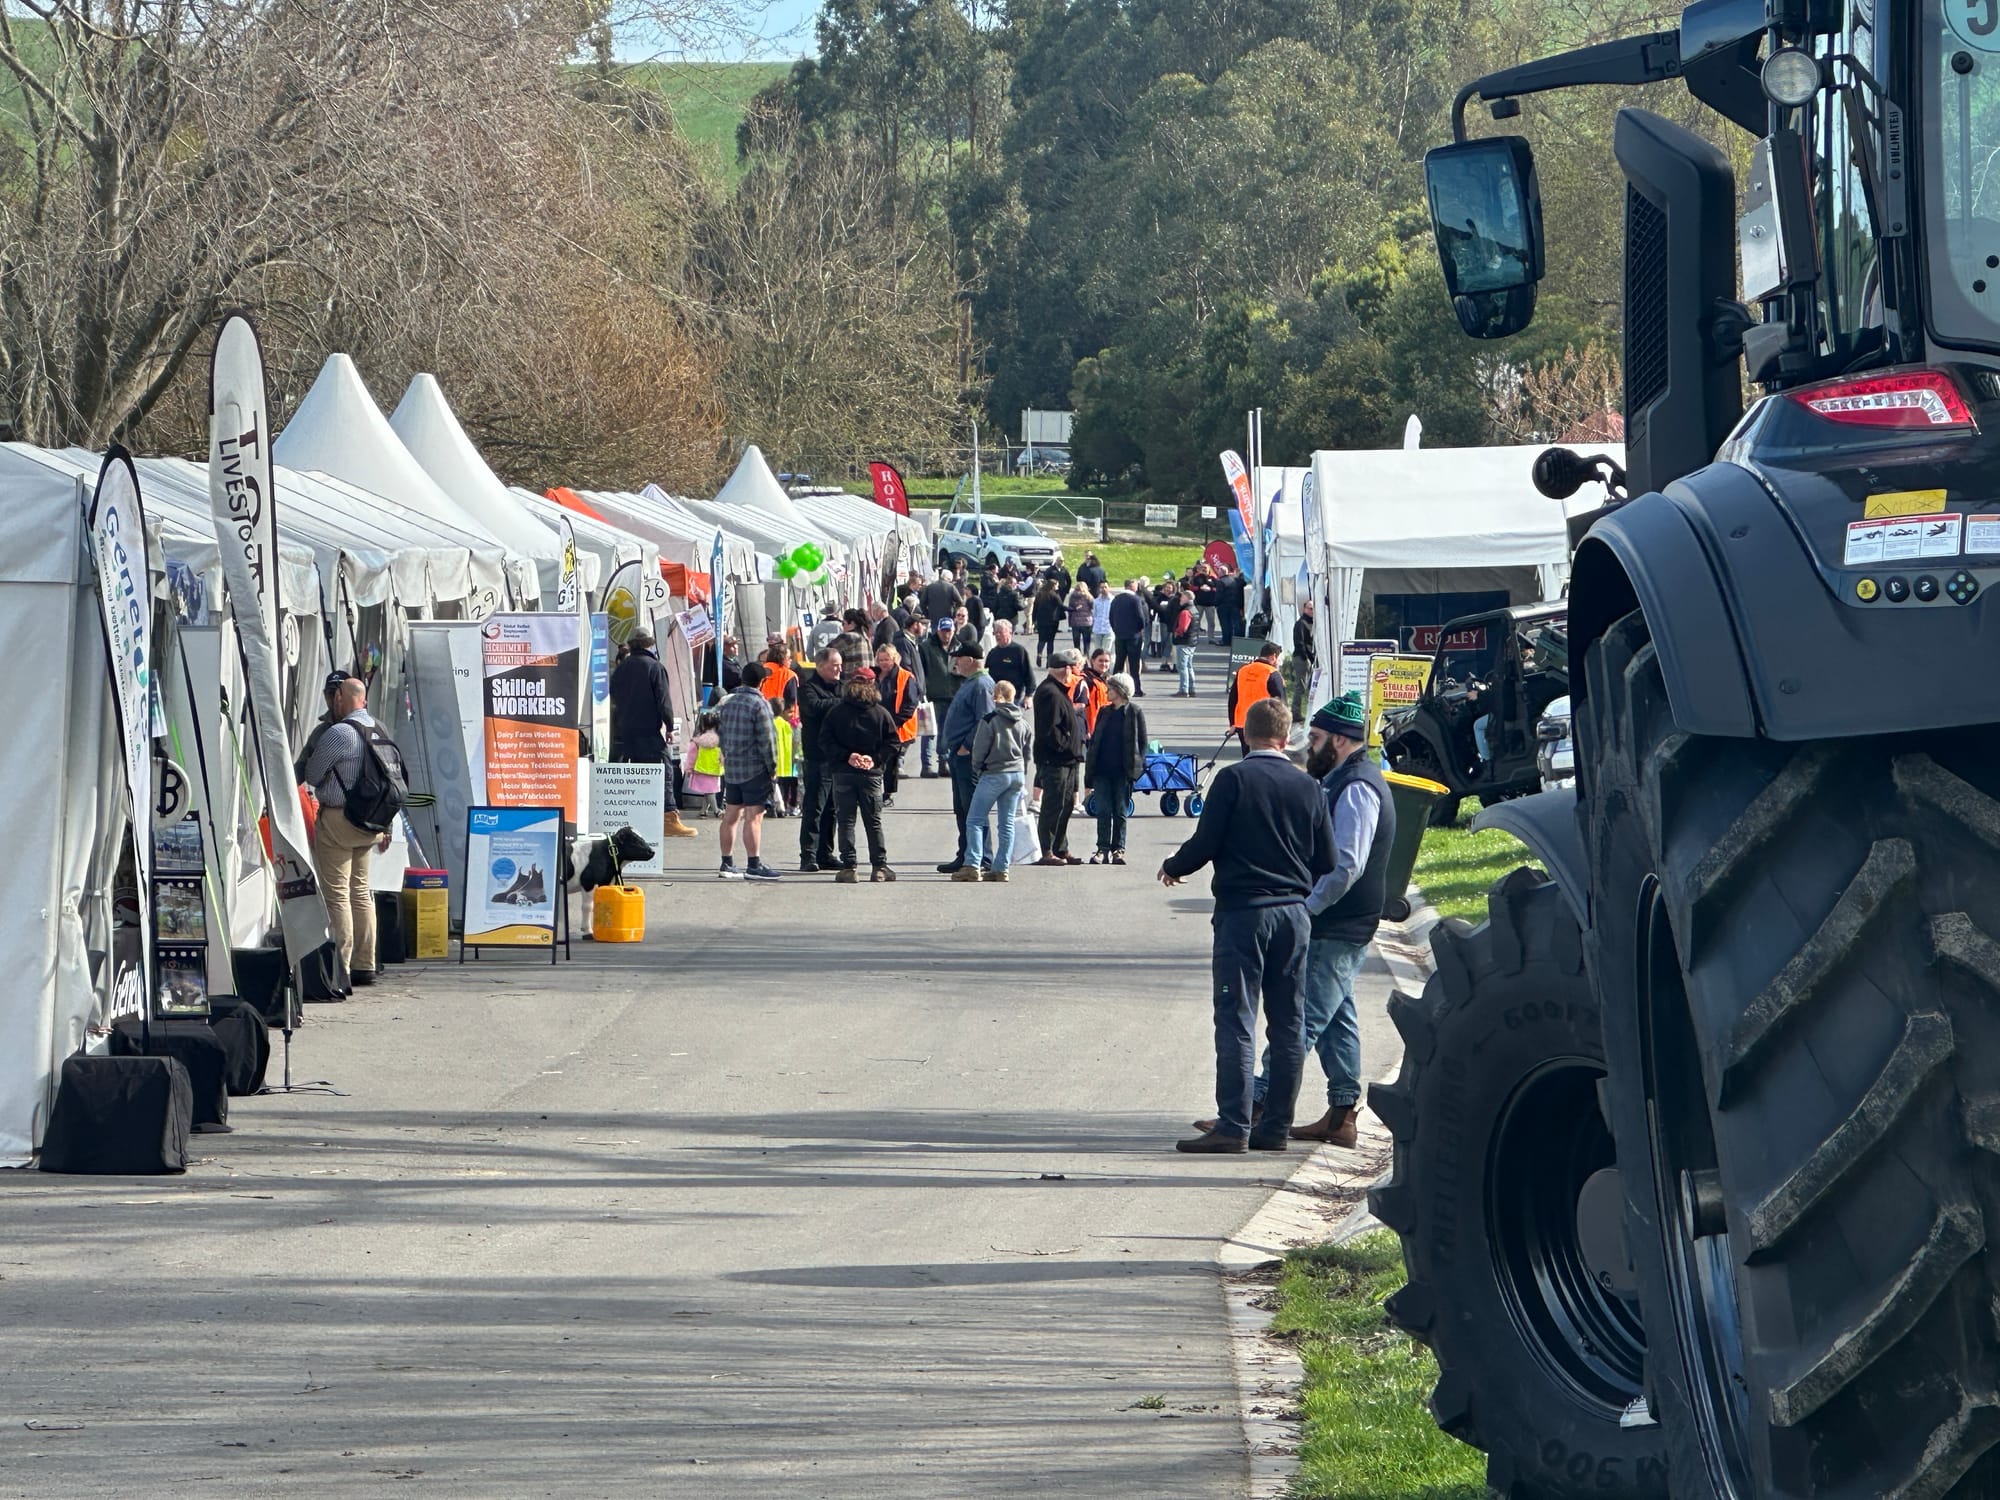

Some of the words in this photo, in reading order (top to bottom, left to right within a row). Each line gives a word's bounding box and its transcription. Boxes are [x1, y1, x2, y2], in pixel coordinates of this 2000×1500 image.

[881, 470, 896, 509] HOT
[218, 437, 264, 581] LIVESTOCK
[644, 581, 664, 602] 26
[471, 591, 495, 620] 29
[492, 679, 546, 696] Skilled
[492, 697, 566, 715] WORKERS
